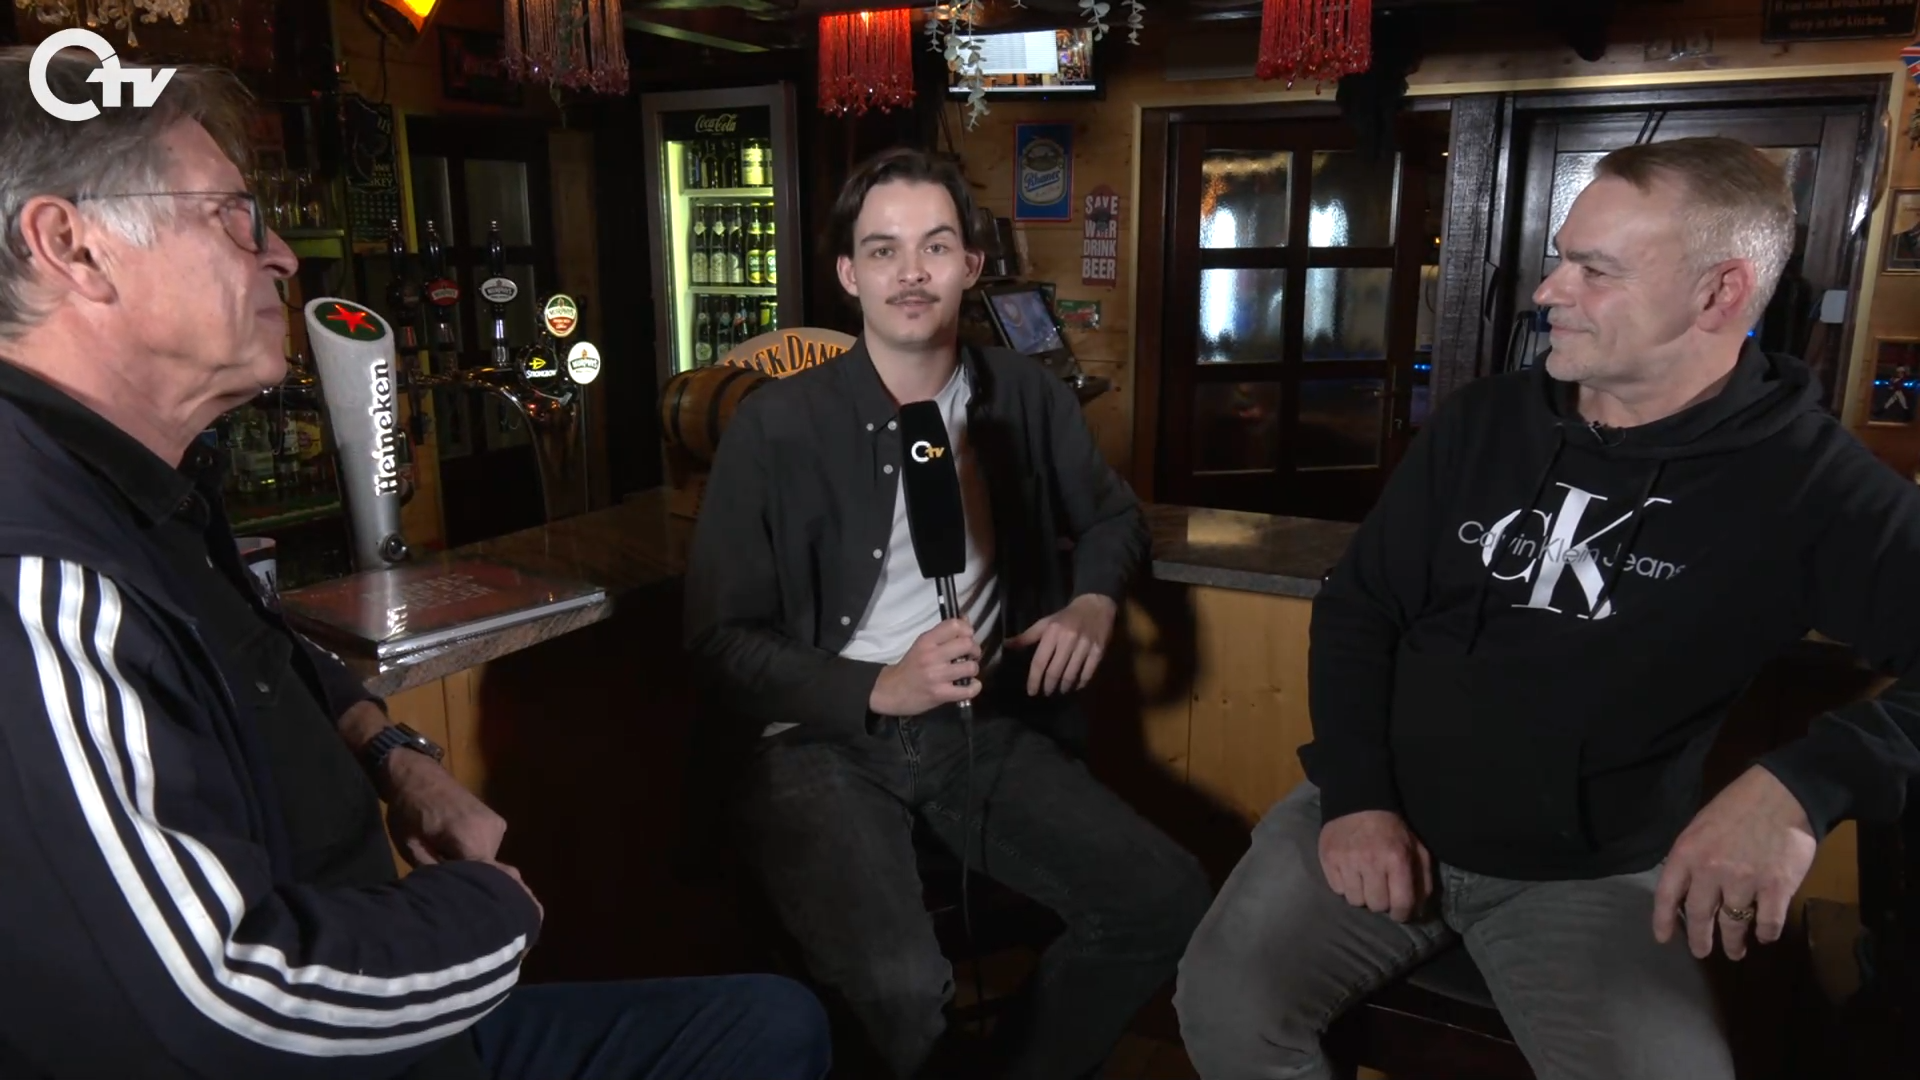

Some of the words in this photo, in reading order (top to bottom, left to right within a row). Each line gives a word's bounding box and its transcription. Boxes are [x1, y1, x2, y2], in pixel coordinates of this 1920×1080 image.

[694, 113, 738, 133] Coca-Cola
[1085, 195, 1119, 215] SAVE
[1084, 219, 1118, 239] WATER
[1083, 239, 1117, 257] DRINK
[1083, 258, 1116, 280] BEER
[727, 344, 787, 376] CK
[369, 358, 398, 497] Heineken
[1457, 520, 1538, 560] Cavin
[1537, 535, 1600, 565] Klein
